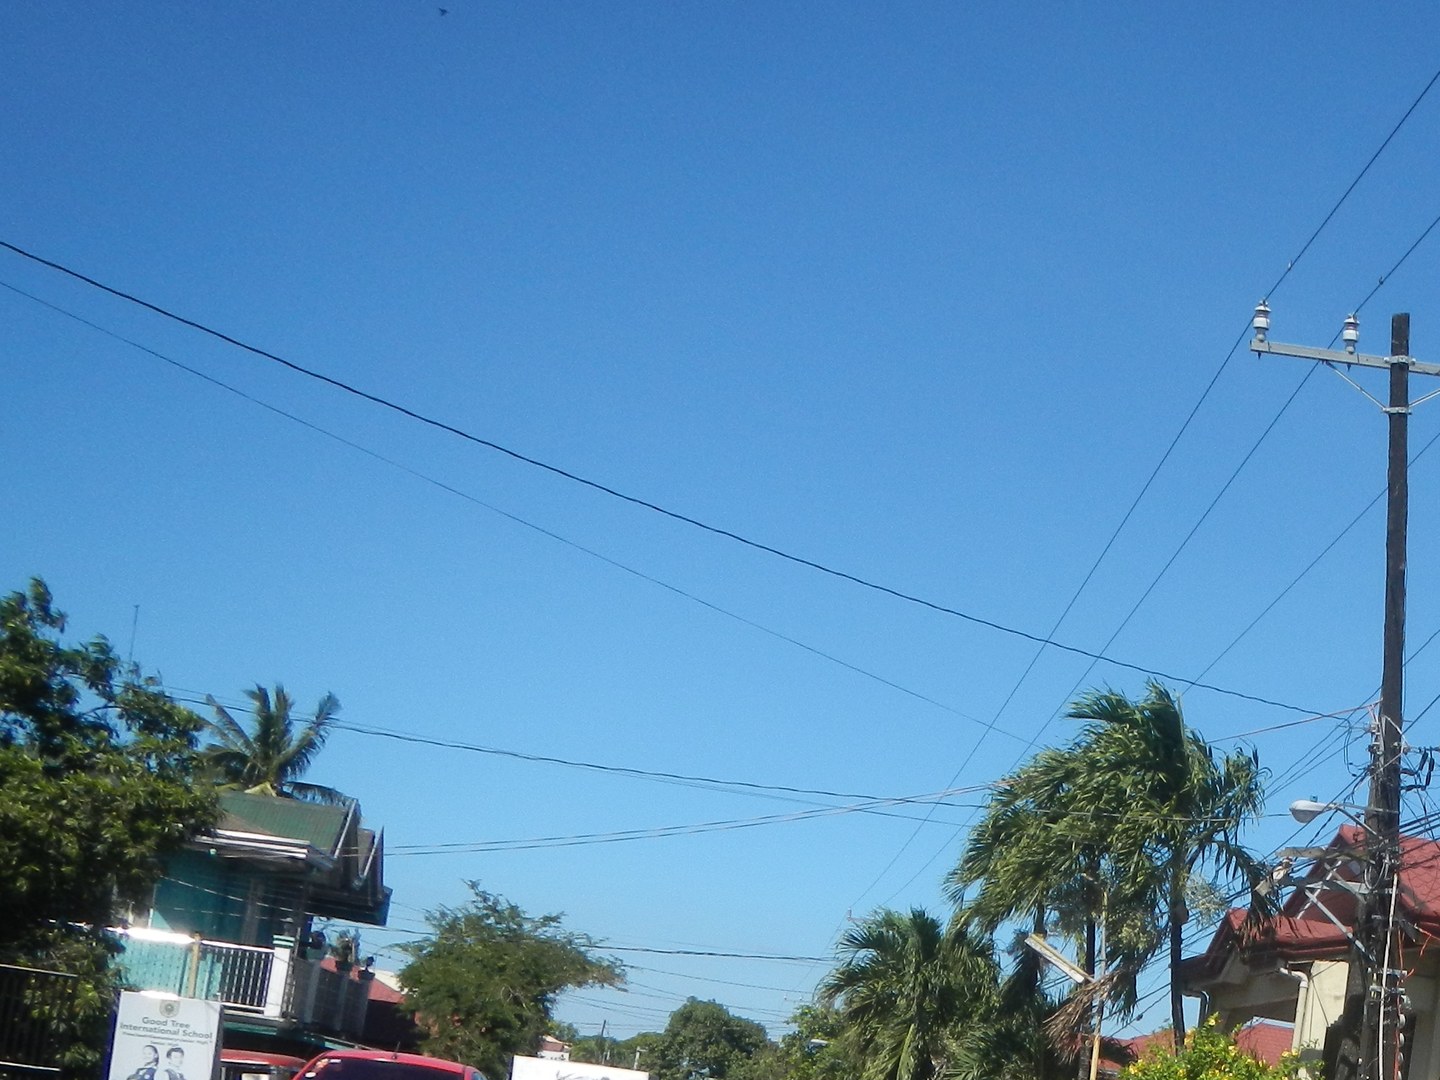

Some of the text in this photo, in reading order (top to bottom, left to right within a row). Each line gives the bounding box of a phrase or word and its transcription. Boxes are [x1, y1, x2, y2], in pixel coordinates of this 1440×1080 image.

[142, 1016, 191, 1028] Good Tree
[120, 1022, 180, 1035] International
[182, 1029, 213, 1039] School
